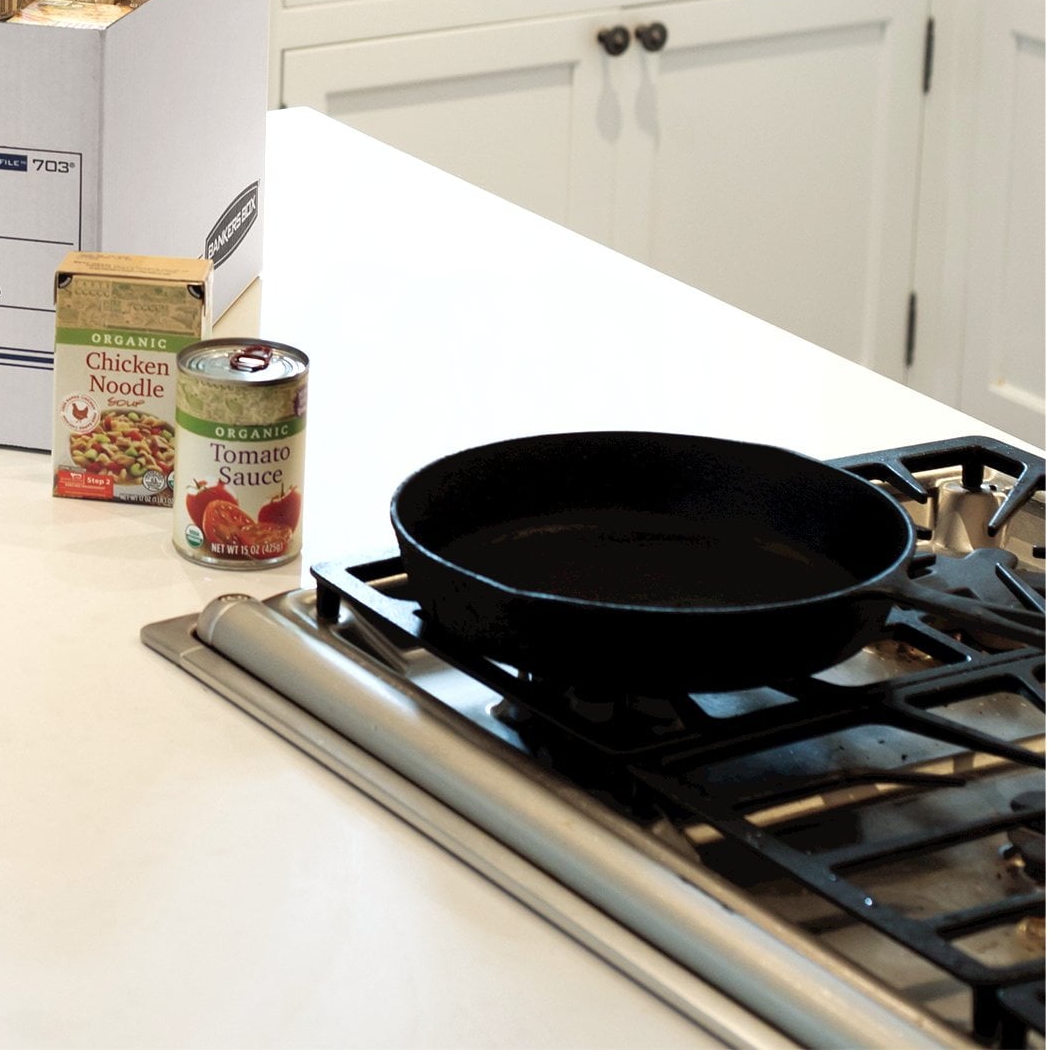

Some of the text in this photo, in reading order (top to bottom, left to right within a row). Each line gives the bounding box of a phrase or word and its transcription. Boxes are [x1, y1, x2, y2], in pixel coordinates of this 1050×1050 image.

[32, 159, 69, 173] 703
[208, 194, 256, 259] BANKERS BOX
[91, 333, 167, 349] ORGANIC
[86, 351, 170, 376] Chicken
[89, 374, 165, 398] Noodle
[215, 425, 289, 439] ORGANIC
[210, 442, 291, 465] Tomato
[86, 477, 106, 486] Step
[219, 466, 283, 487] Sauce
[211, 542, 283, 555] NET WT 15 OZ (425g)
